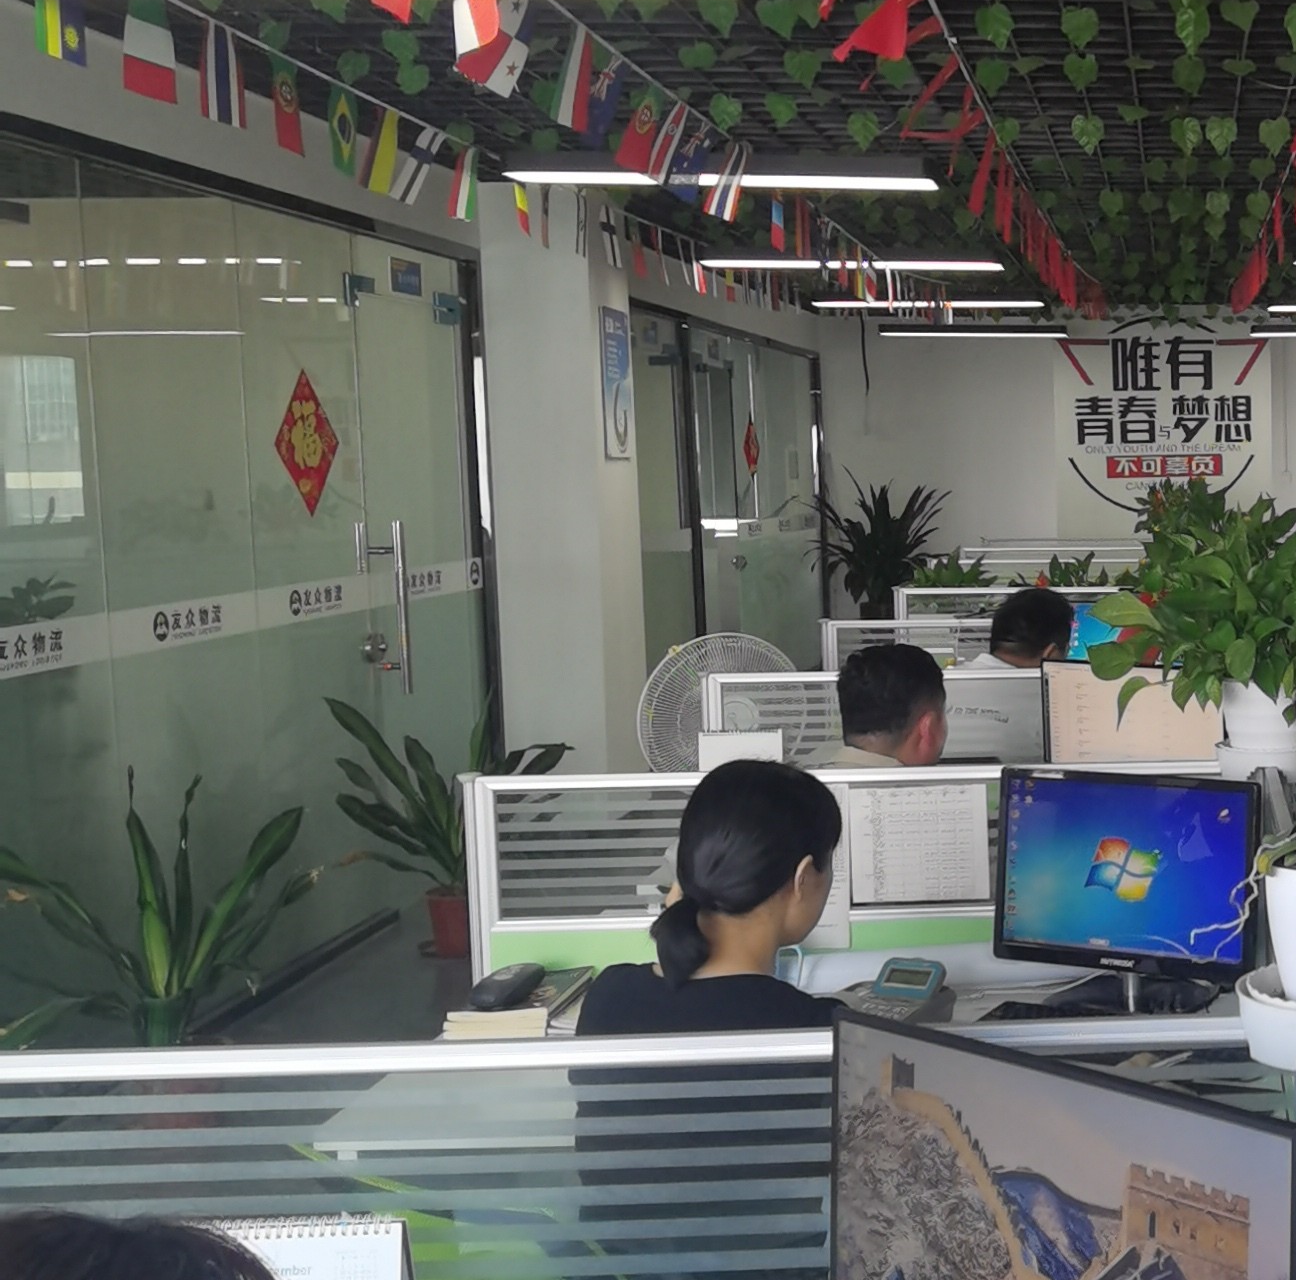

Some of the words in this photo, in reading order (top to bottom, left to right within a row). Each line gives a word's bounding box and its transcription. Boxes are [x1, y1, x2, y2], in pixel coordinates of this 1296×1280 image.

[1111, 336, 1215, 391] 唯有
[1075, 394, 1252, 445] 青春与梦想
[1085, 444, 1116, 455] ONLY
